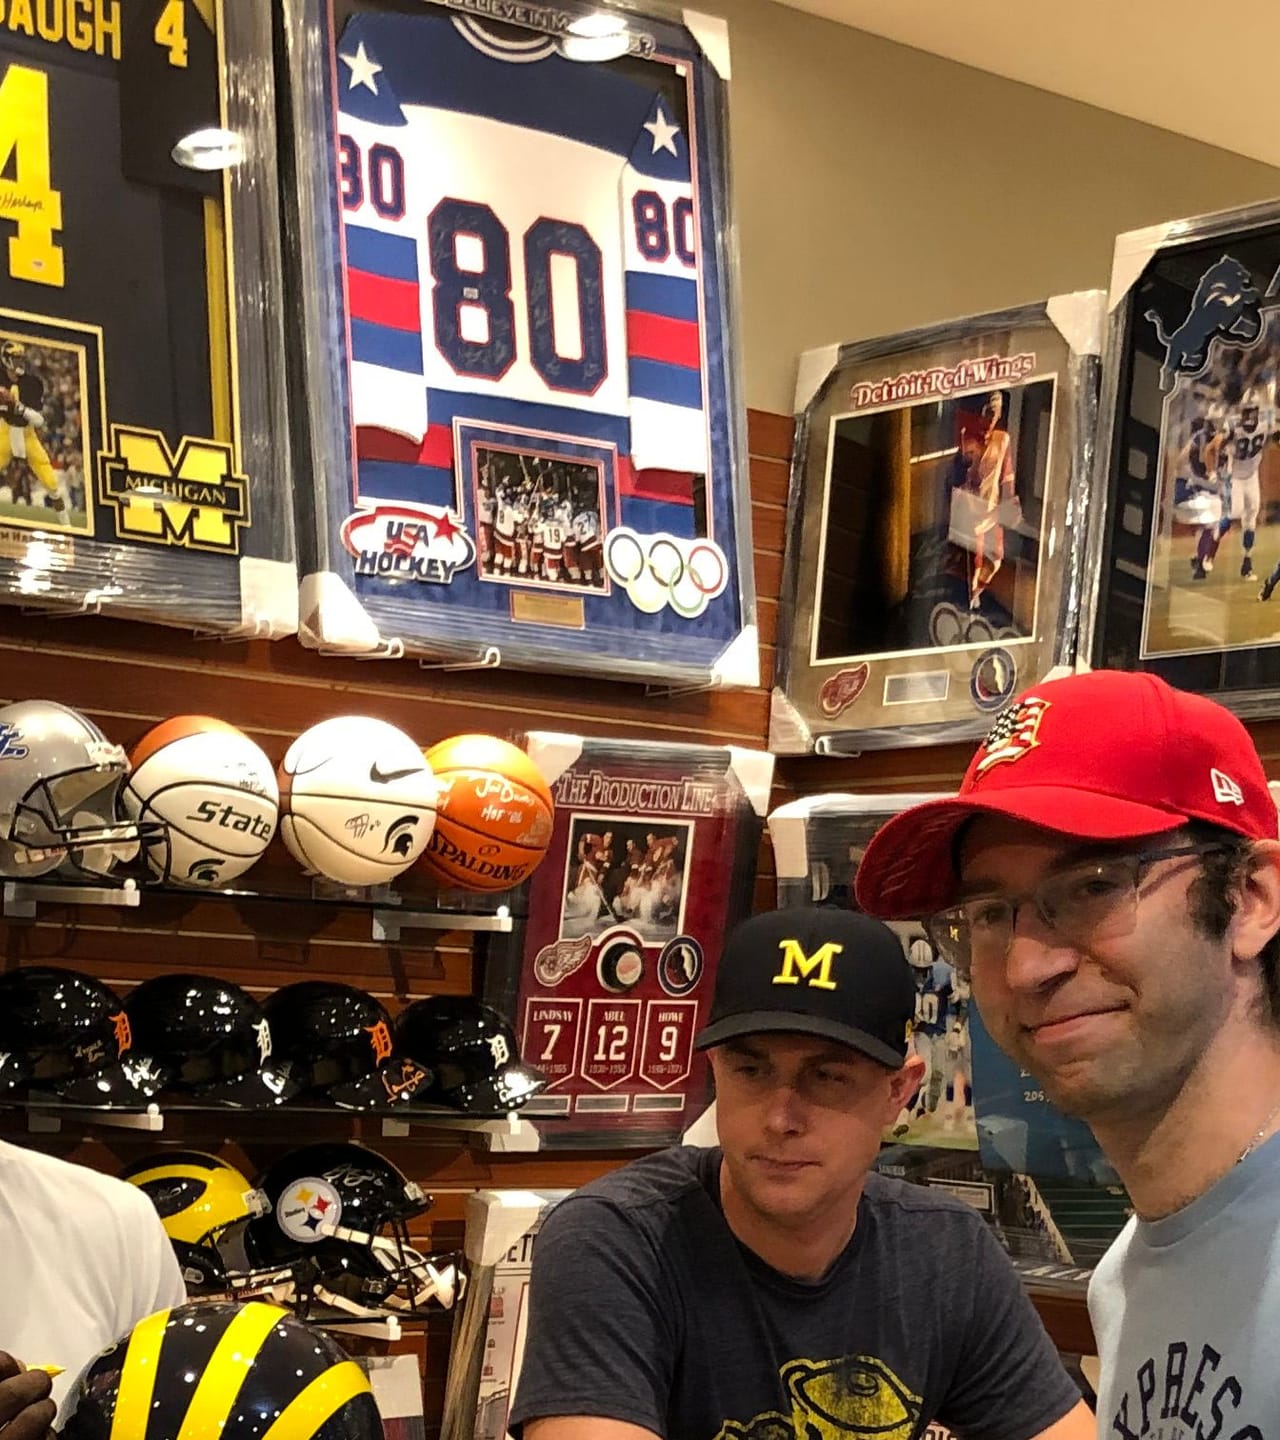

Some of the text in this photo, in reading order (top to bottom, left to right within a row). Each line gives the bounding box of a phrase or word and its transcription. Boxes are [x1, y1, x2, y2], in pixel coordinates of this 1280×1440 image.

[154, 0, 189, 67] 4
[632, 189, 697, 269] 80
[427, 197, 609, 396] 80
[853, 356, 1034, 407] Detroit Red Wings
[125, 474, 227, 506] MICHIGAN
[386, 520, 429, 549] USA
[357, 549, 458, 582] HOCKEY
[559, 771, 588, 804] THE
[590, 773, 681, 812] PRODUCTION
[682, 782, 714, 813] LINE
[186, 800, 272, 842] State
[426, 829, 529, 881] SPALDING
[772, 938, 844, 991] M
[533, 1010, 574, 1023] LINDSAY
[604, 1010, 626, 1023] ABEL
[658, 1011, 685, 1024] HOWE
[539, 1024, 562, 1062] 7
[593, 1024, 629, 1062] 12
[658, 1025, 679, 1062] 9
